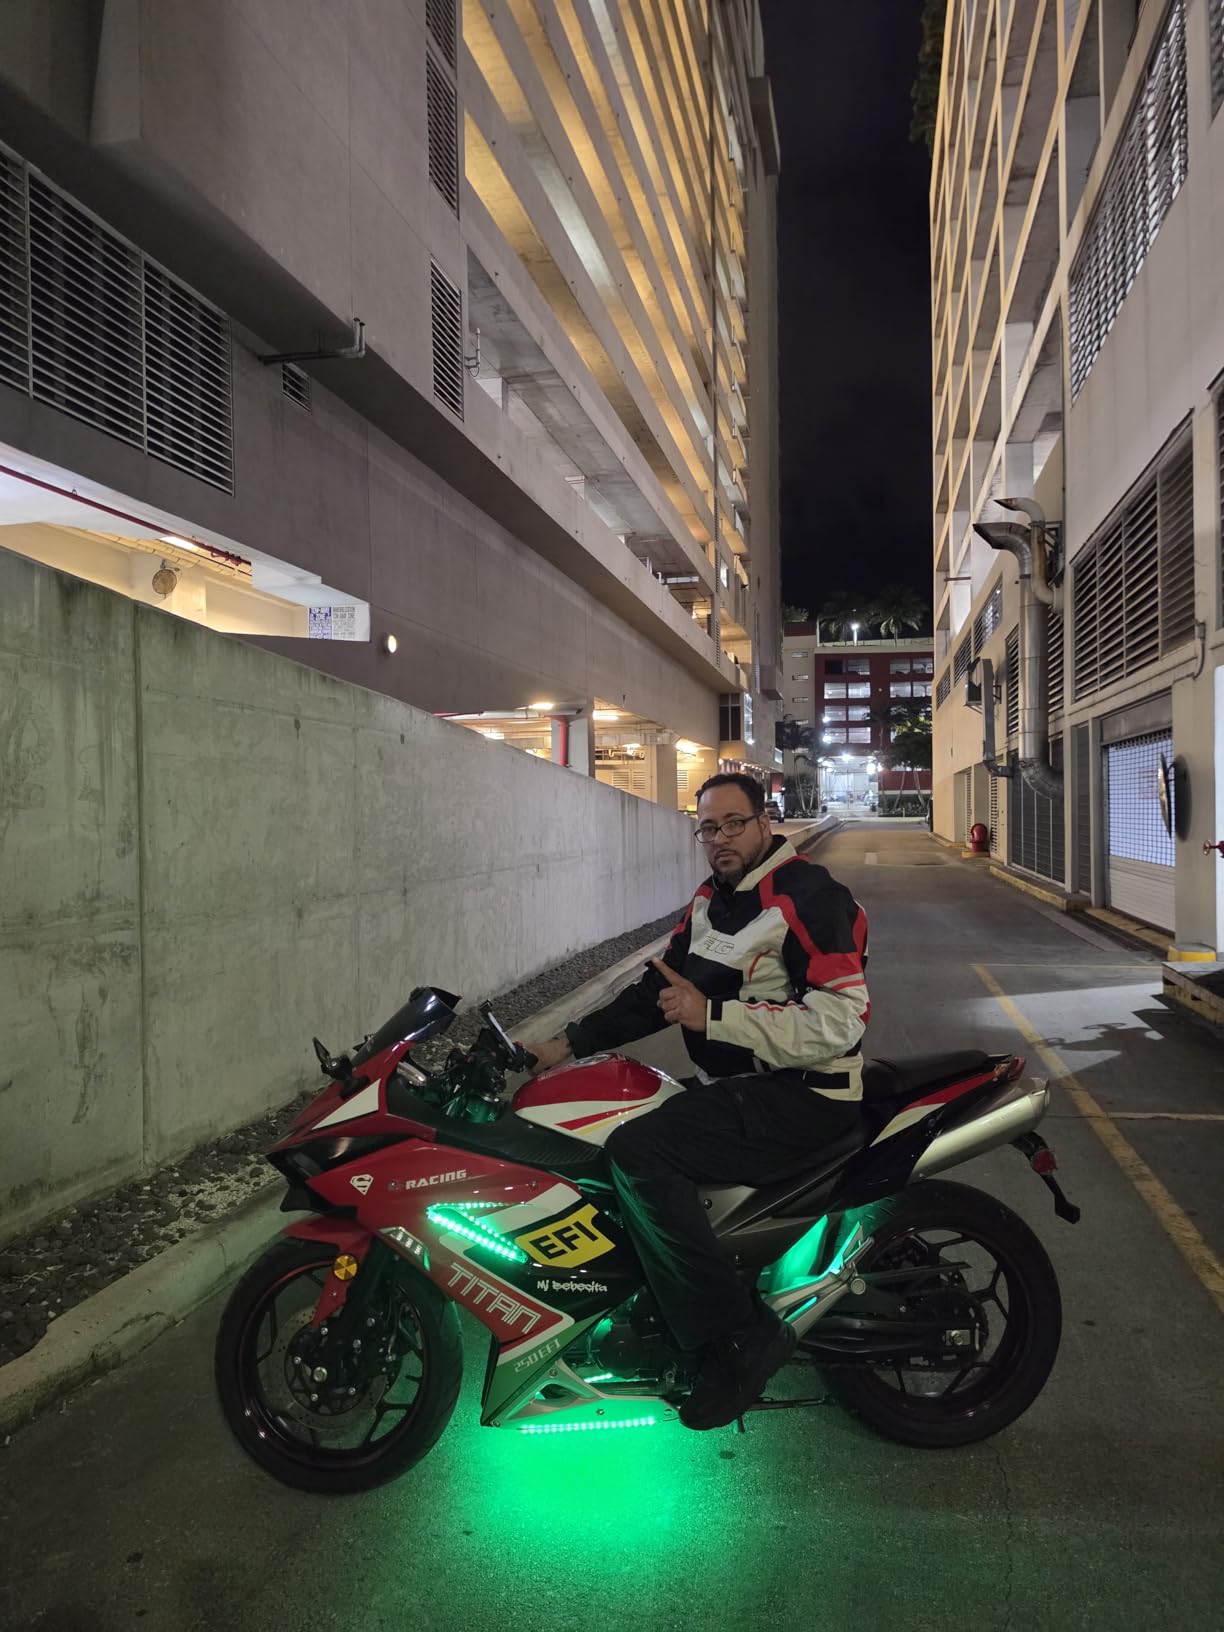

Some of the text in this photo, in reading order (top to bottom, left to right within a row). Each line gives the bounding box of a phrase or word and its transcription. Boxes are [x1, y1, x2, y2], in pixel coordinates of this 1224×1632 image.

[406, 1169, 467, 1190] RACING
[530, 1221, 599, 1260] EFI
[447, 1263, 542, 1334] TITAN
